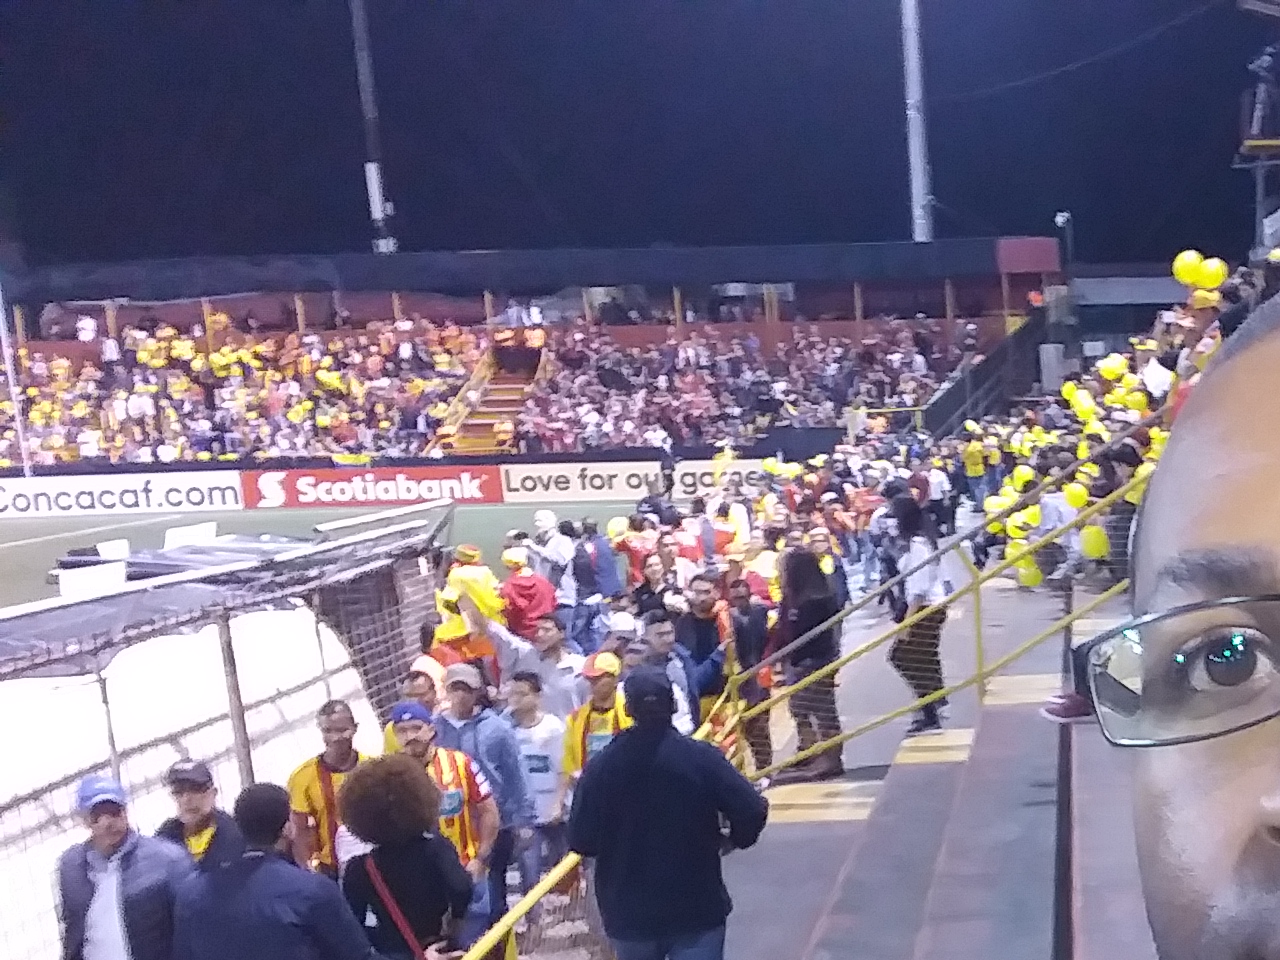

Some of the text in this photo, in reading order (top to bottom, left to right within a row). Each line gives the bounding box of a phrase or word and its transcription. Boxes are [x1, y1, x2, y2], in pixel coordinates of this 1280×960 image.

[296, 471, 484, 503] Scotiabank
[504, 468, 570, 492] Love
[577, 467, 618, 490] for
